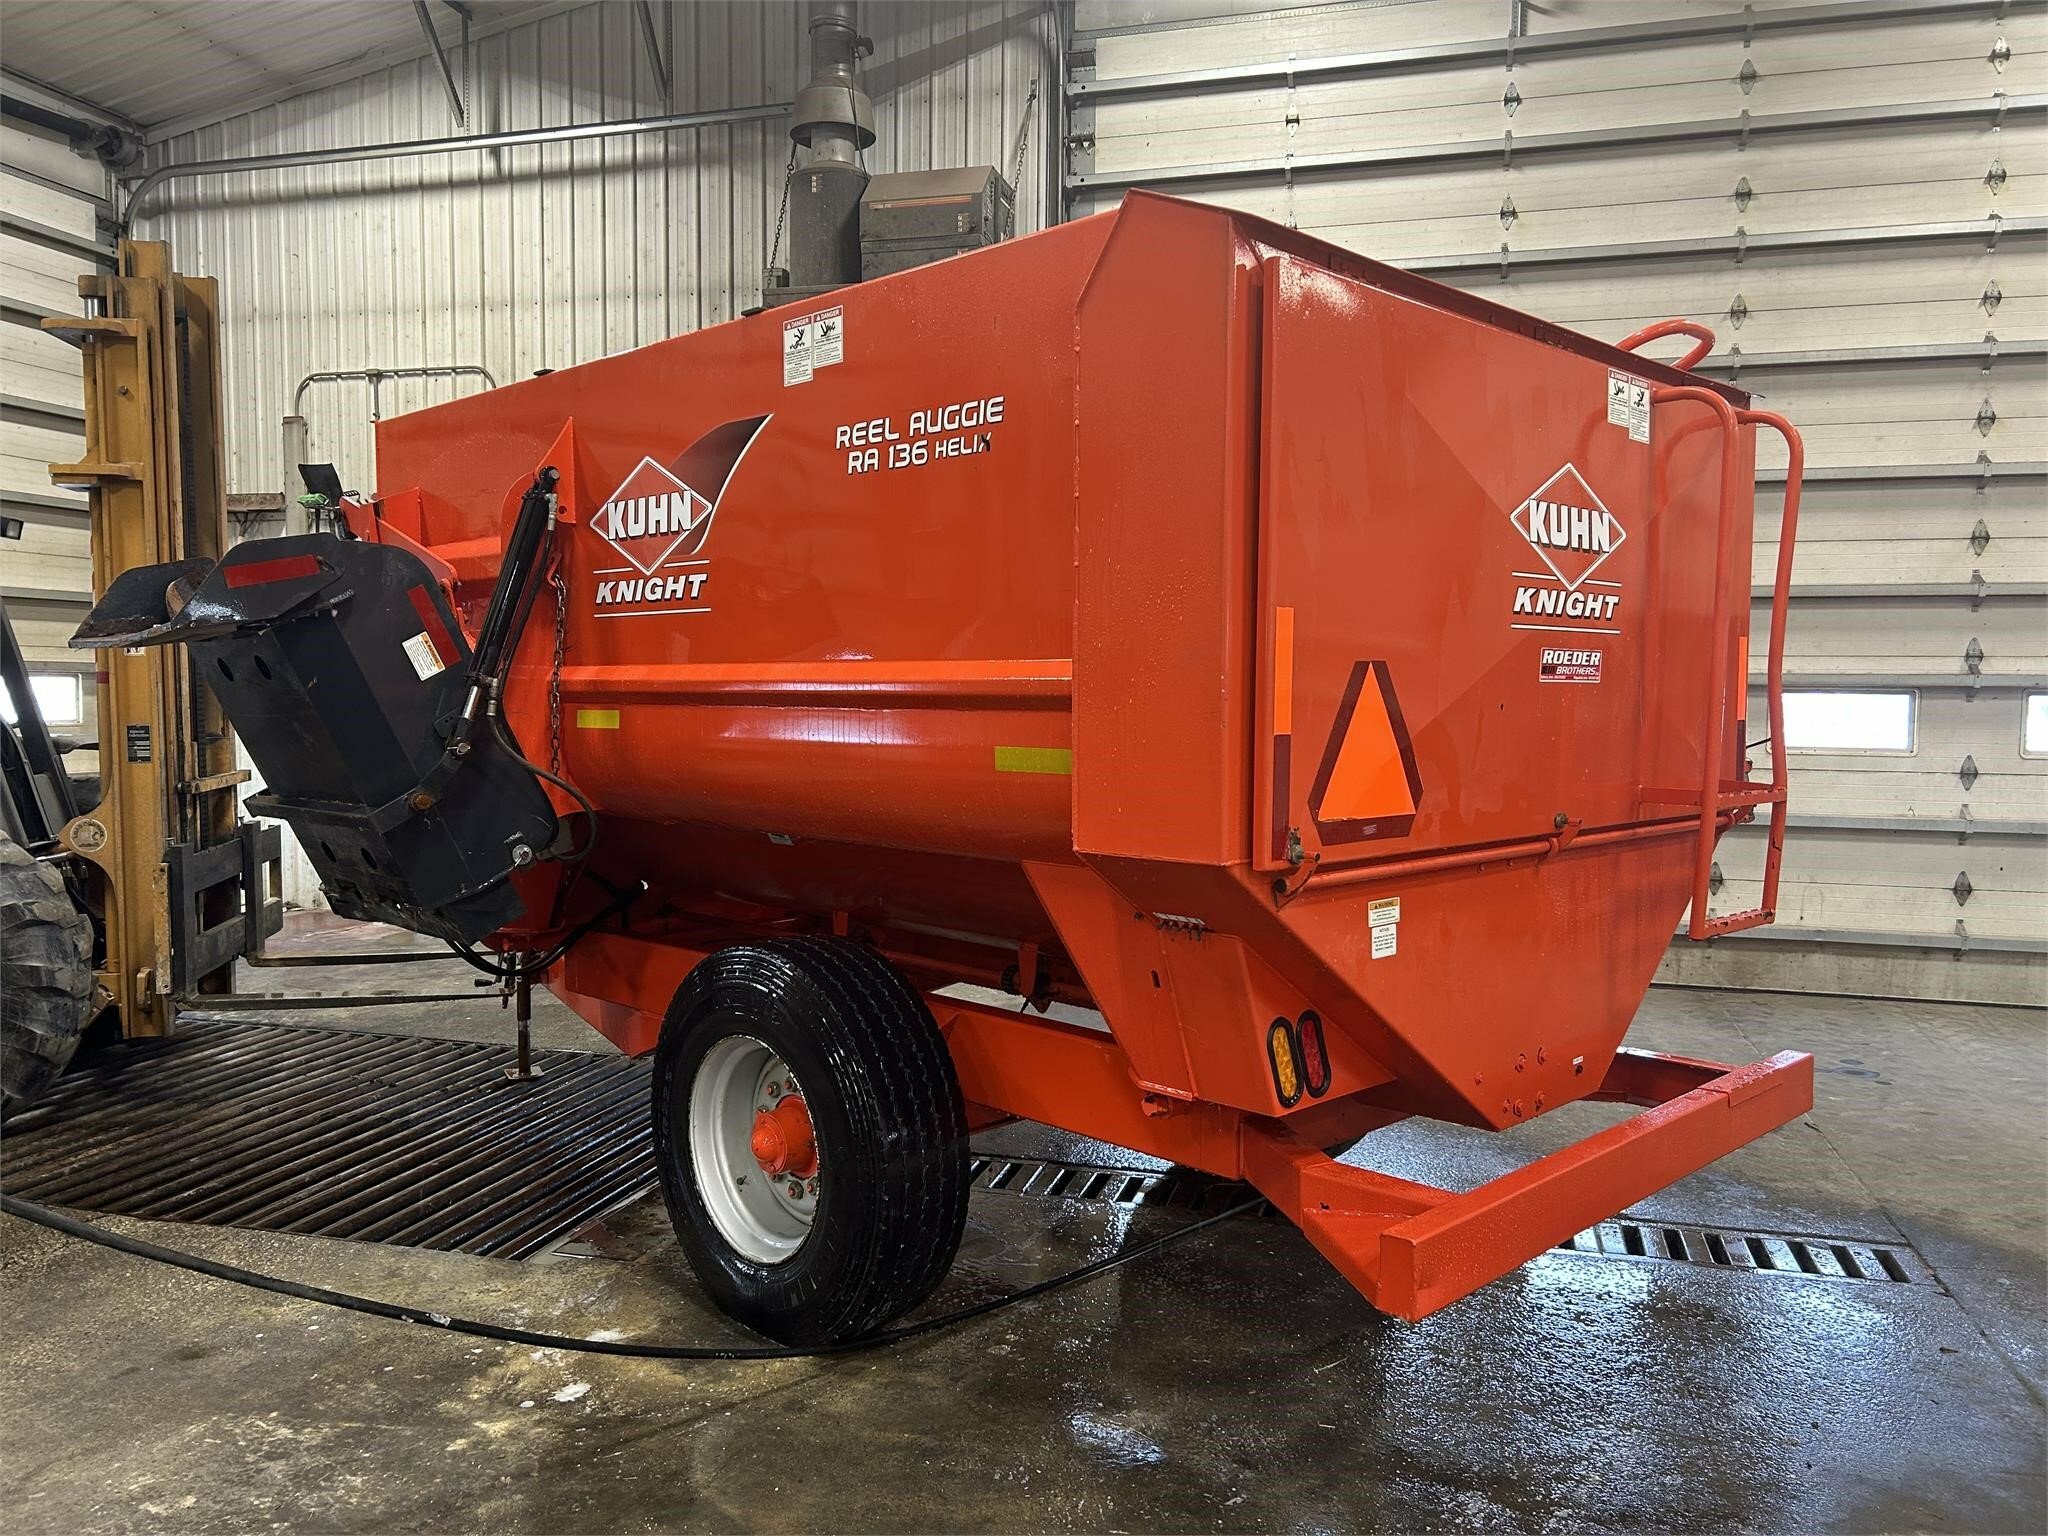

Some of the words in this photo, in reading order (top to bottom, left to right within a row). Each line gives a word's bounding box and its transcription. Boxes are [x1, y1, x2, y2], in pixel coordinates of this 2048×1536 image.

[791, 317, 809, 328] DANGER
[820, 309, 840, 320] DANGER
[836, 417, 900, 449] REEL
[909, 396, 1004, 437] AUGGIE
[848, 447, 880, 474] RA
[888, 439, 928, 469] 136
[607, 489, 692, 541] KUHN
[1529, 499, 1610, 553] KUHN
[595, 573, 708, 605] KNIGHT
[1513, 587, 1620, 620] KNIGHT
[1542, 650, 1601, 665] ROEDER
[1556, 666, 1597, 675] BROTHERS
